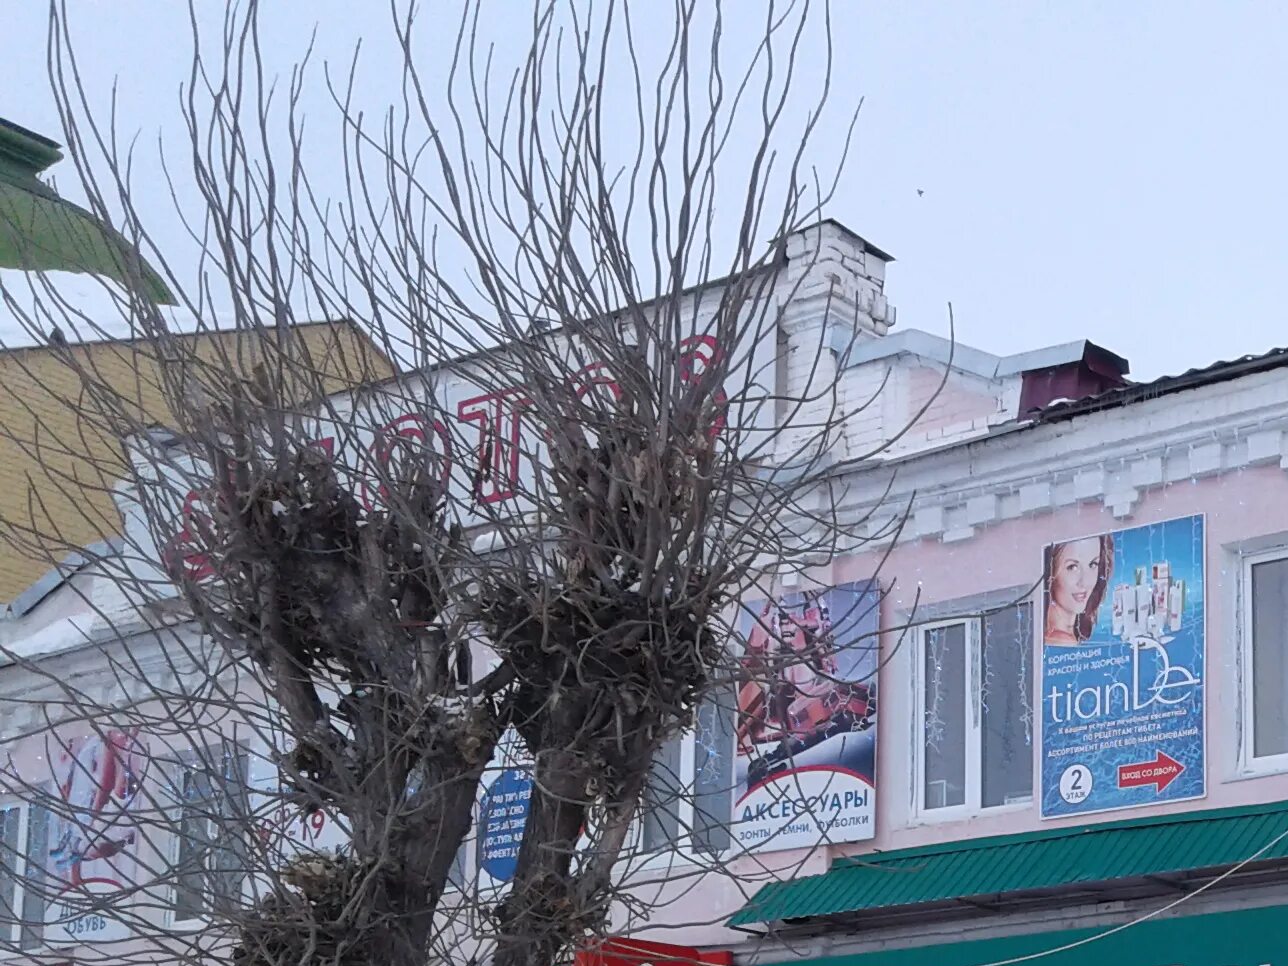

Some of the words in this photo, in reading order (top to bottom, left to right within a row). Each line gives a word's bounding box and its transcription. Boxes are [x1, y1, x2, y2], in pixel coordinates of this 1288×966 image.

[1071, 769, 1083, 791] 2
[1121, 771, 1140, 781] ВХОД
[1142, 769, 1152, 778] СО
[1153, 766, 1178, 777] ДВОРА
[741, 788, 868, 822] АКСЕССУАРЫ
[1065, 791, 1086, 801] ЭТАЖ
